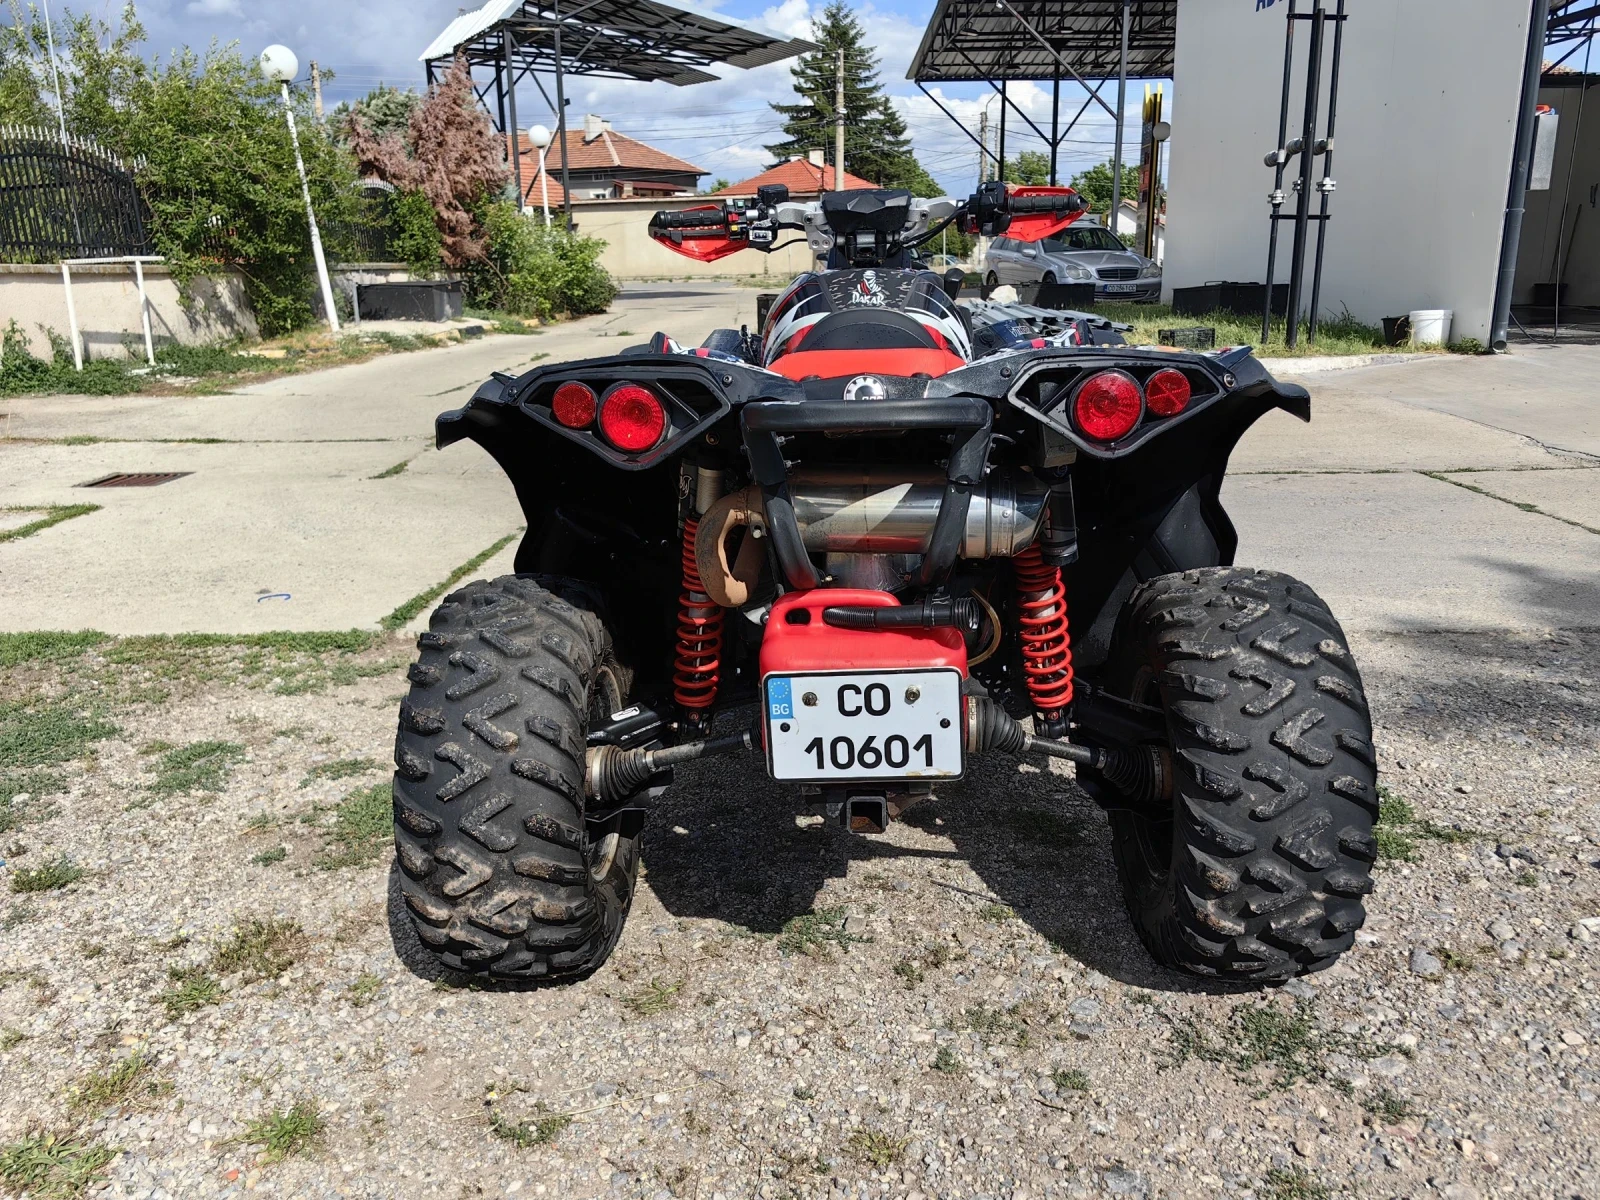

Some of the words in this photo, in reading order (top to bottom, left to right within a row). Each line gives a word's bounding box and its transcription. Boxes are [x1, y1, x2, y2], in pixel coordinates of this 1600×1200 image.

[852, 291, 886, 306] DAKAR
[772, 703, 790, 715] BG
[837, 682, 891, 717] CO
[804, 734, 934, 770] 10601
